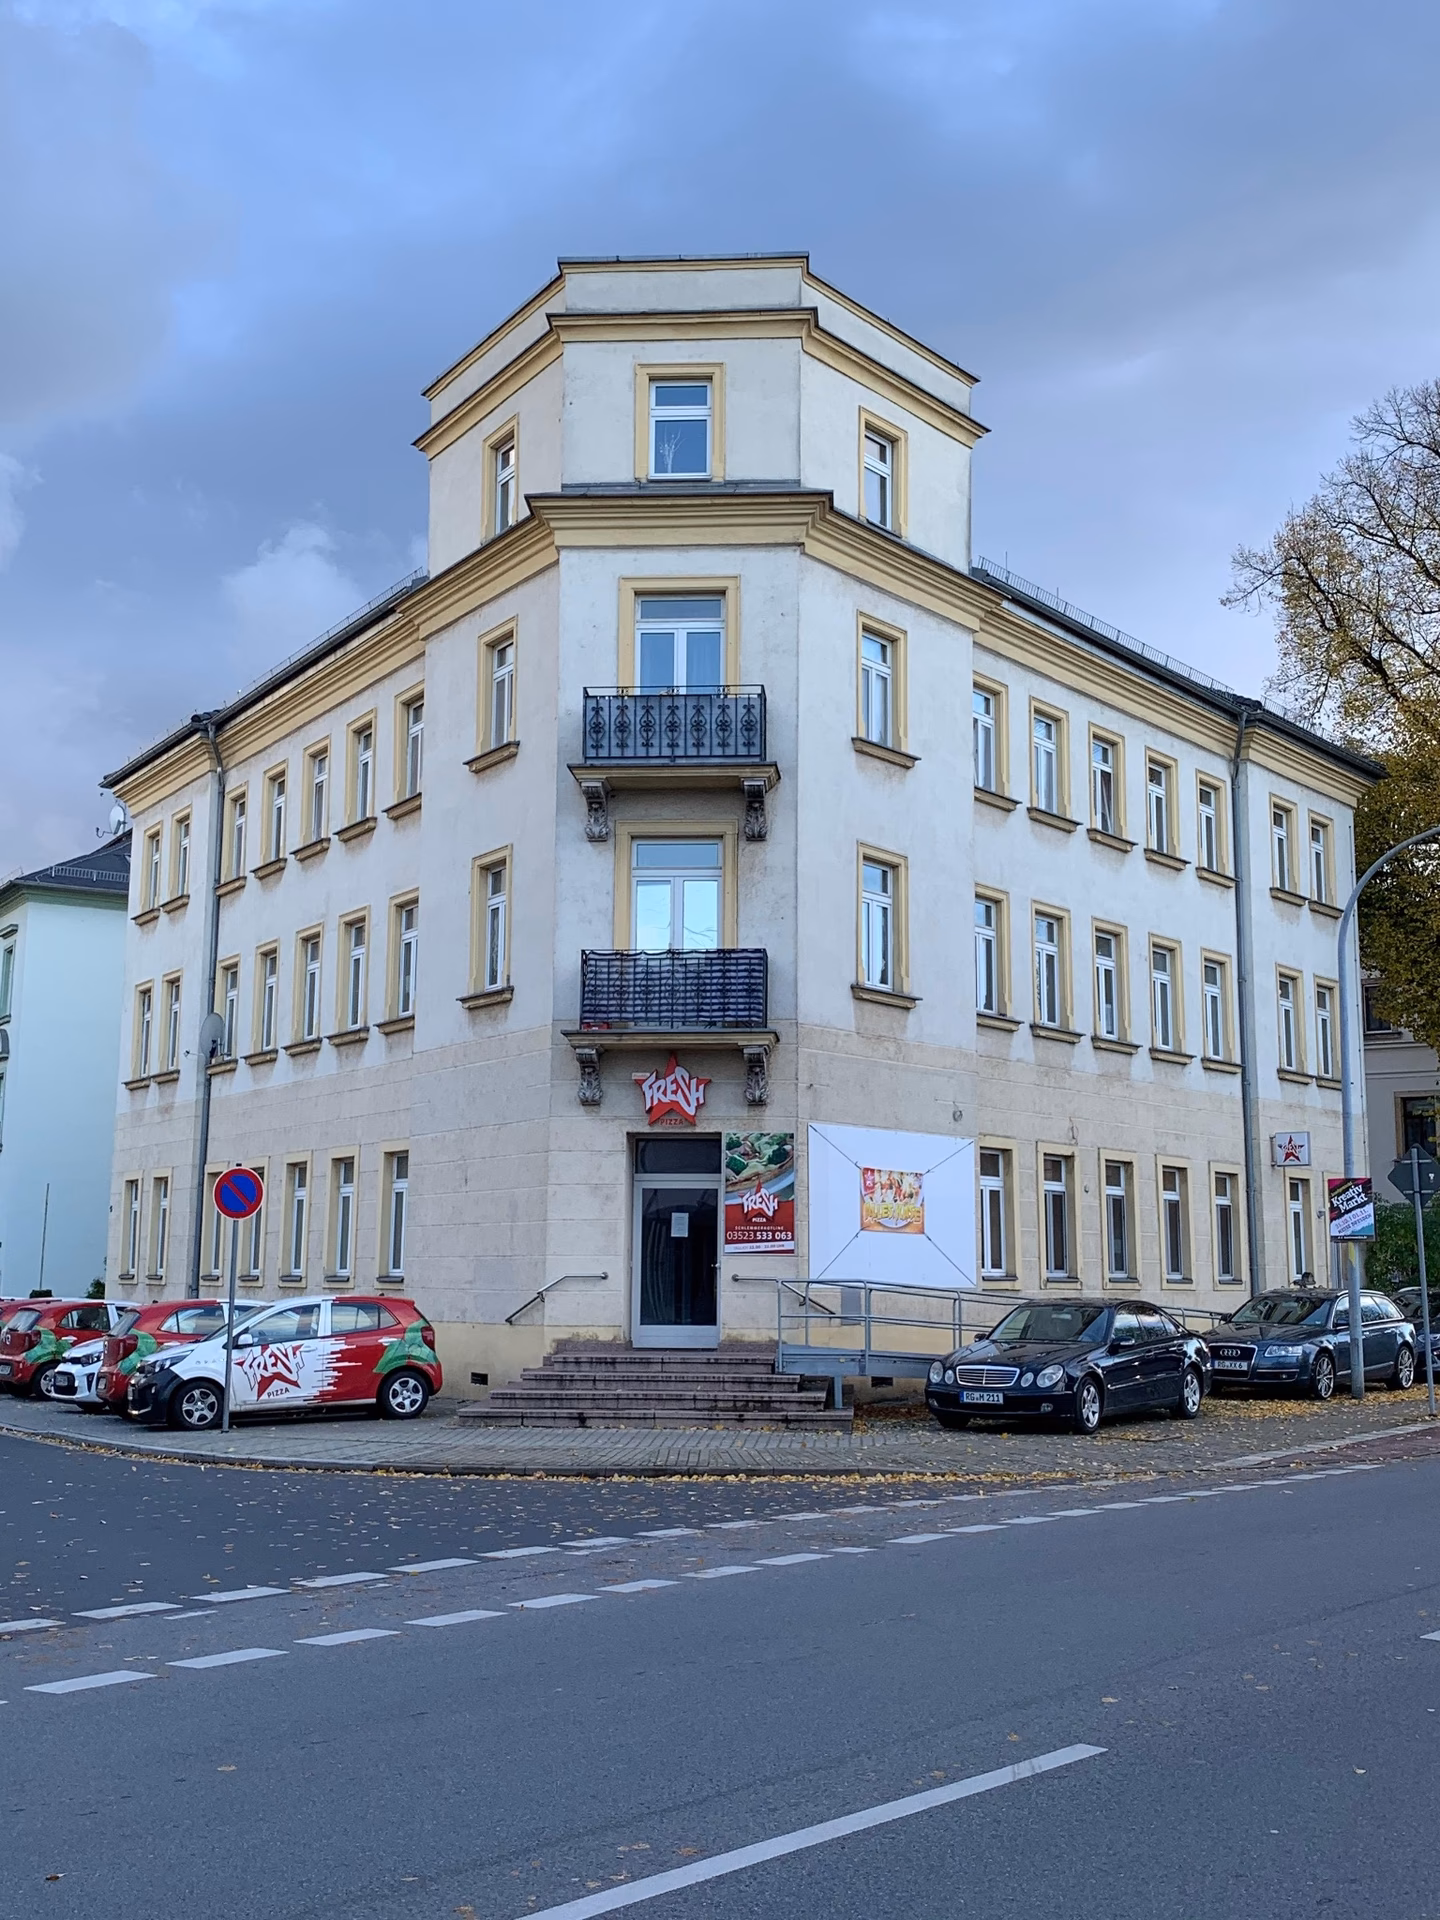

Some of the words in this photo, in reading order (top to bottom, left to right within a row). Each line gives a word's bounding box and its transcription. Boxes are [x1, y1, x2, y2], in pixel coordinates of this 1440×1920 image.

[642, 1065, 705, 1116] FRESH
[660, 1118, 684, 1126] PIZZA
[743, 1187, 778, 1217] FRESH
[1331, 1184, 1363, 1207] Kreativ
[1338, 1193, 1368, 1213] Markt
[756, 1231, 772, 1240] 533
[775, 1231, 792, 1240] 063
[242, 1343, 305, 1391] FRESH
[267, 1387, 290, 1399] PIZZA
[966, 1393, 975, 1401] RG
[986, 1394, 1000, 1402] 211
